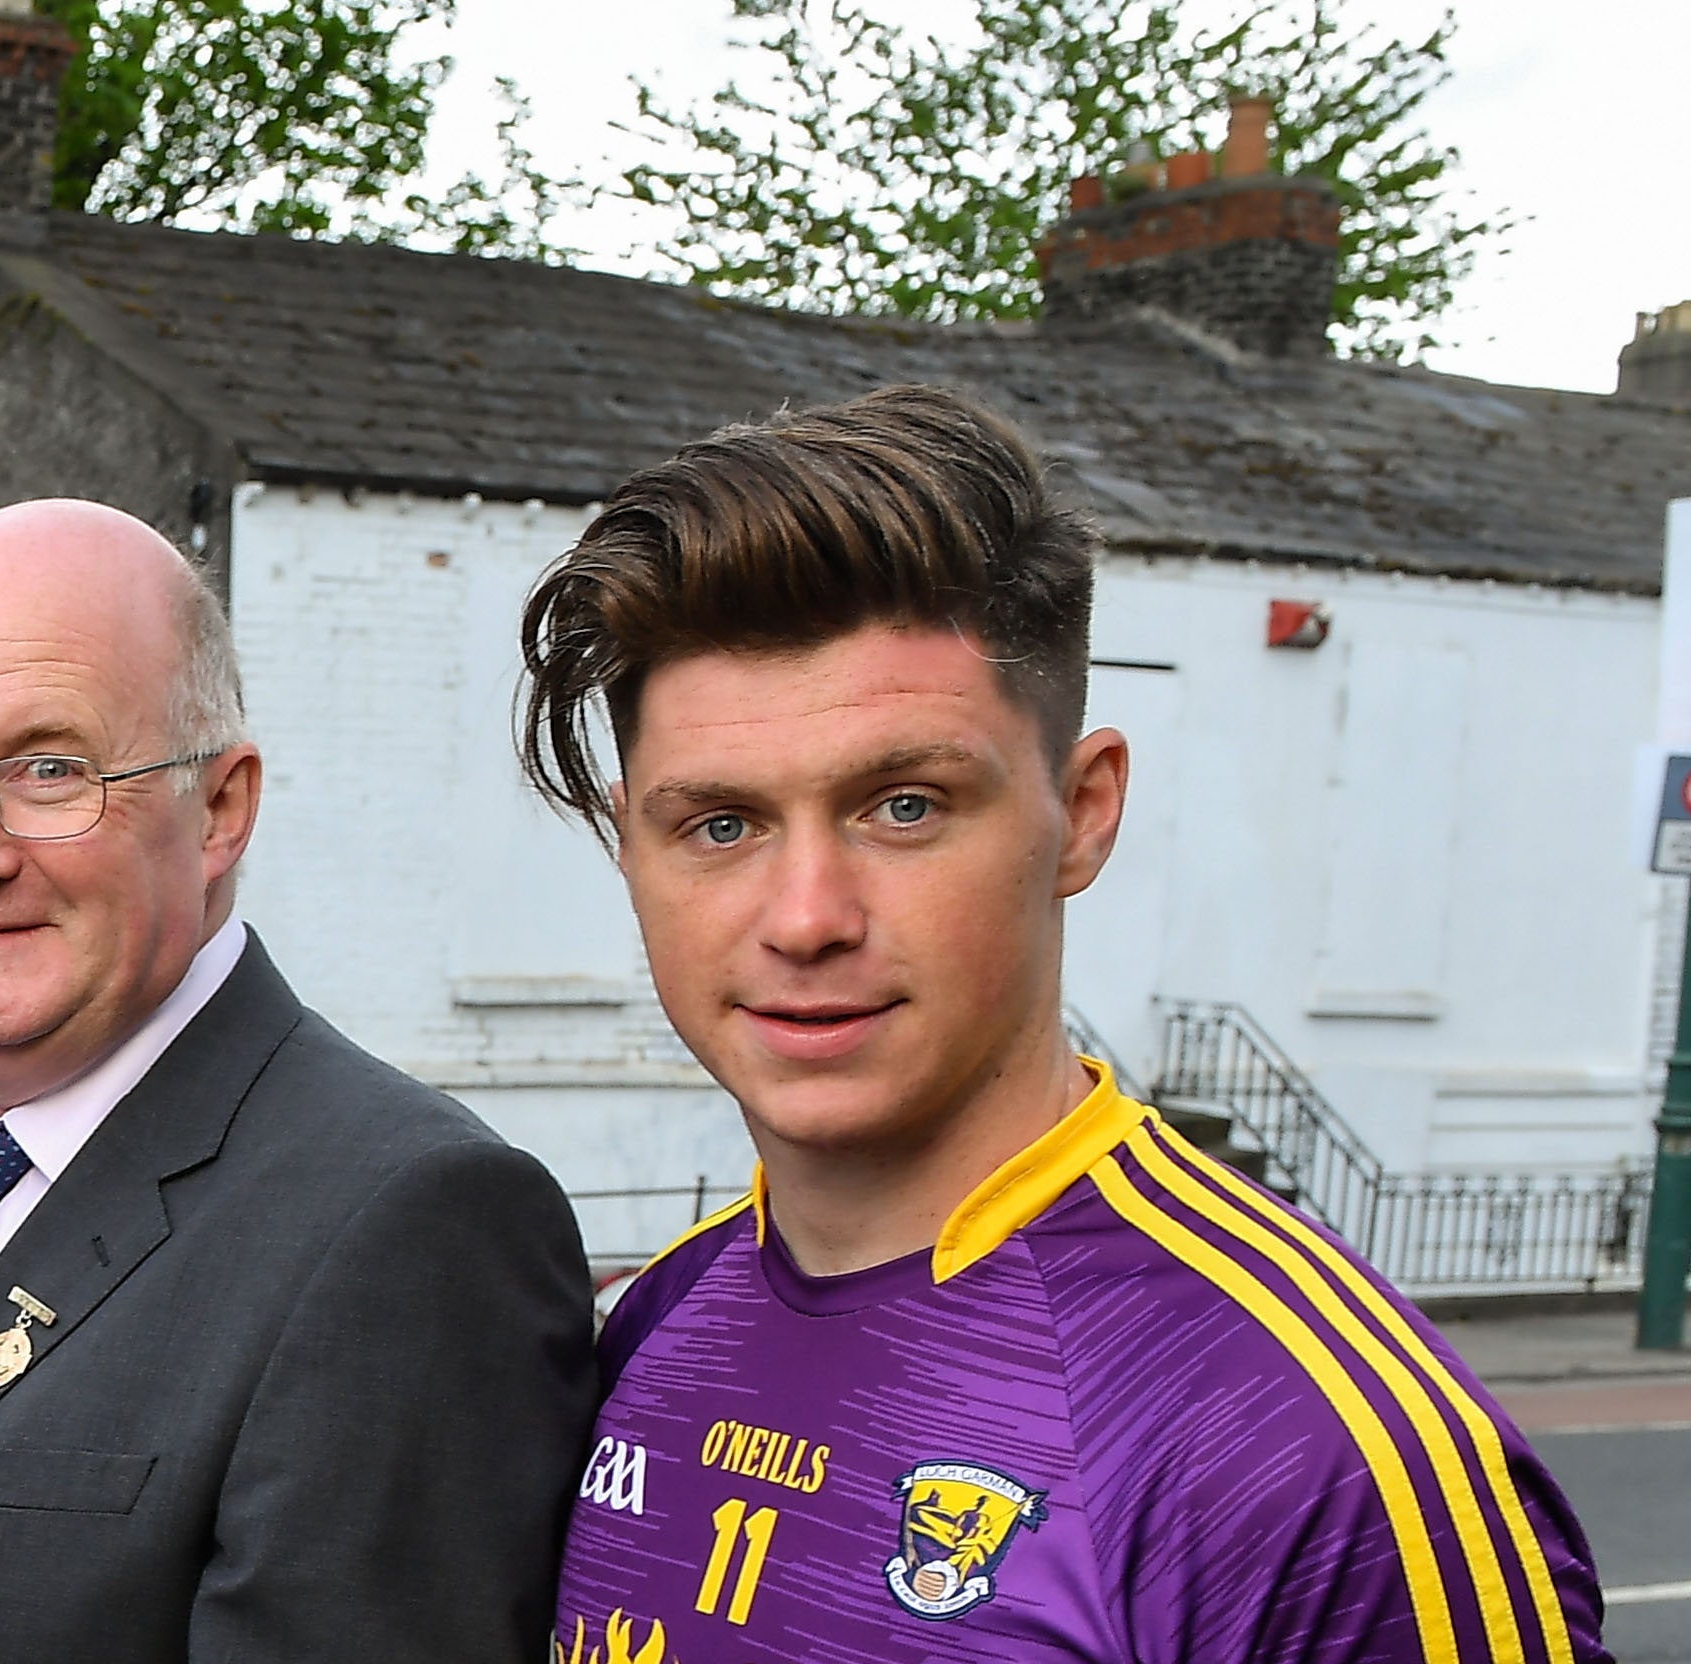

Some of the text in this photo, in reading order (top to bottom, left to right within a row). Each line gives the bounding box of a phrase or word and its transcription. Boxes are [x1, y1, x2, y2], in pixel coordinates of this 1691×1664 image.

[579, 1436, 646, 1515] GAA
[701, 1420, 831, 1495] O'NEILLS
[695, 1499, 779, 1626] 11
